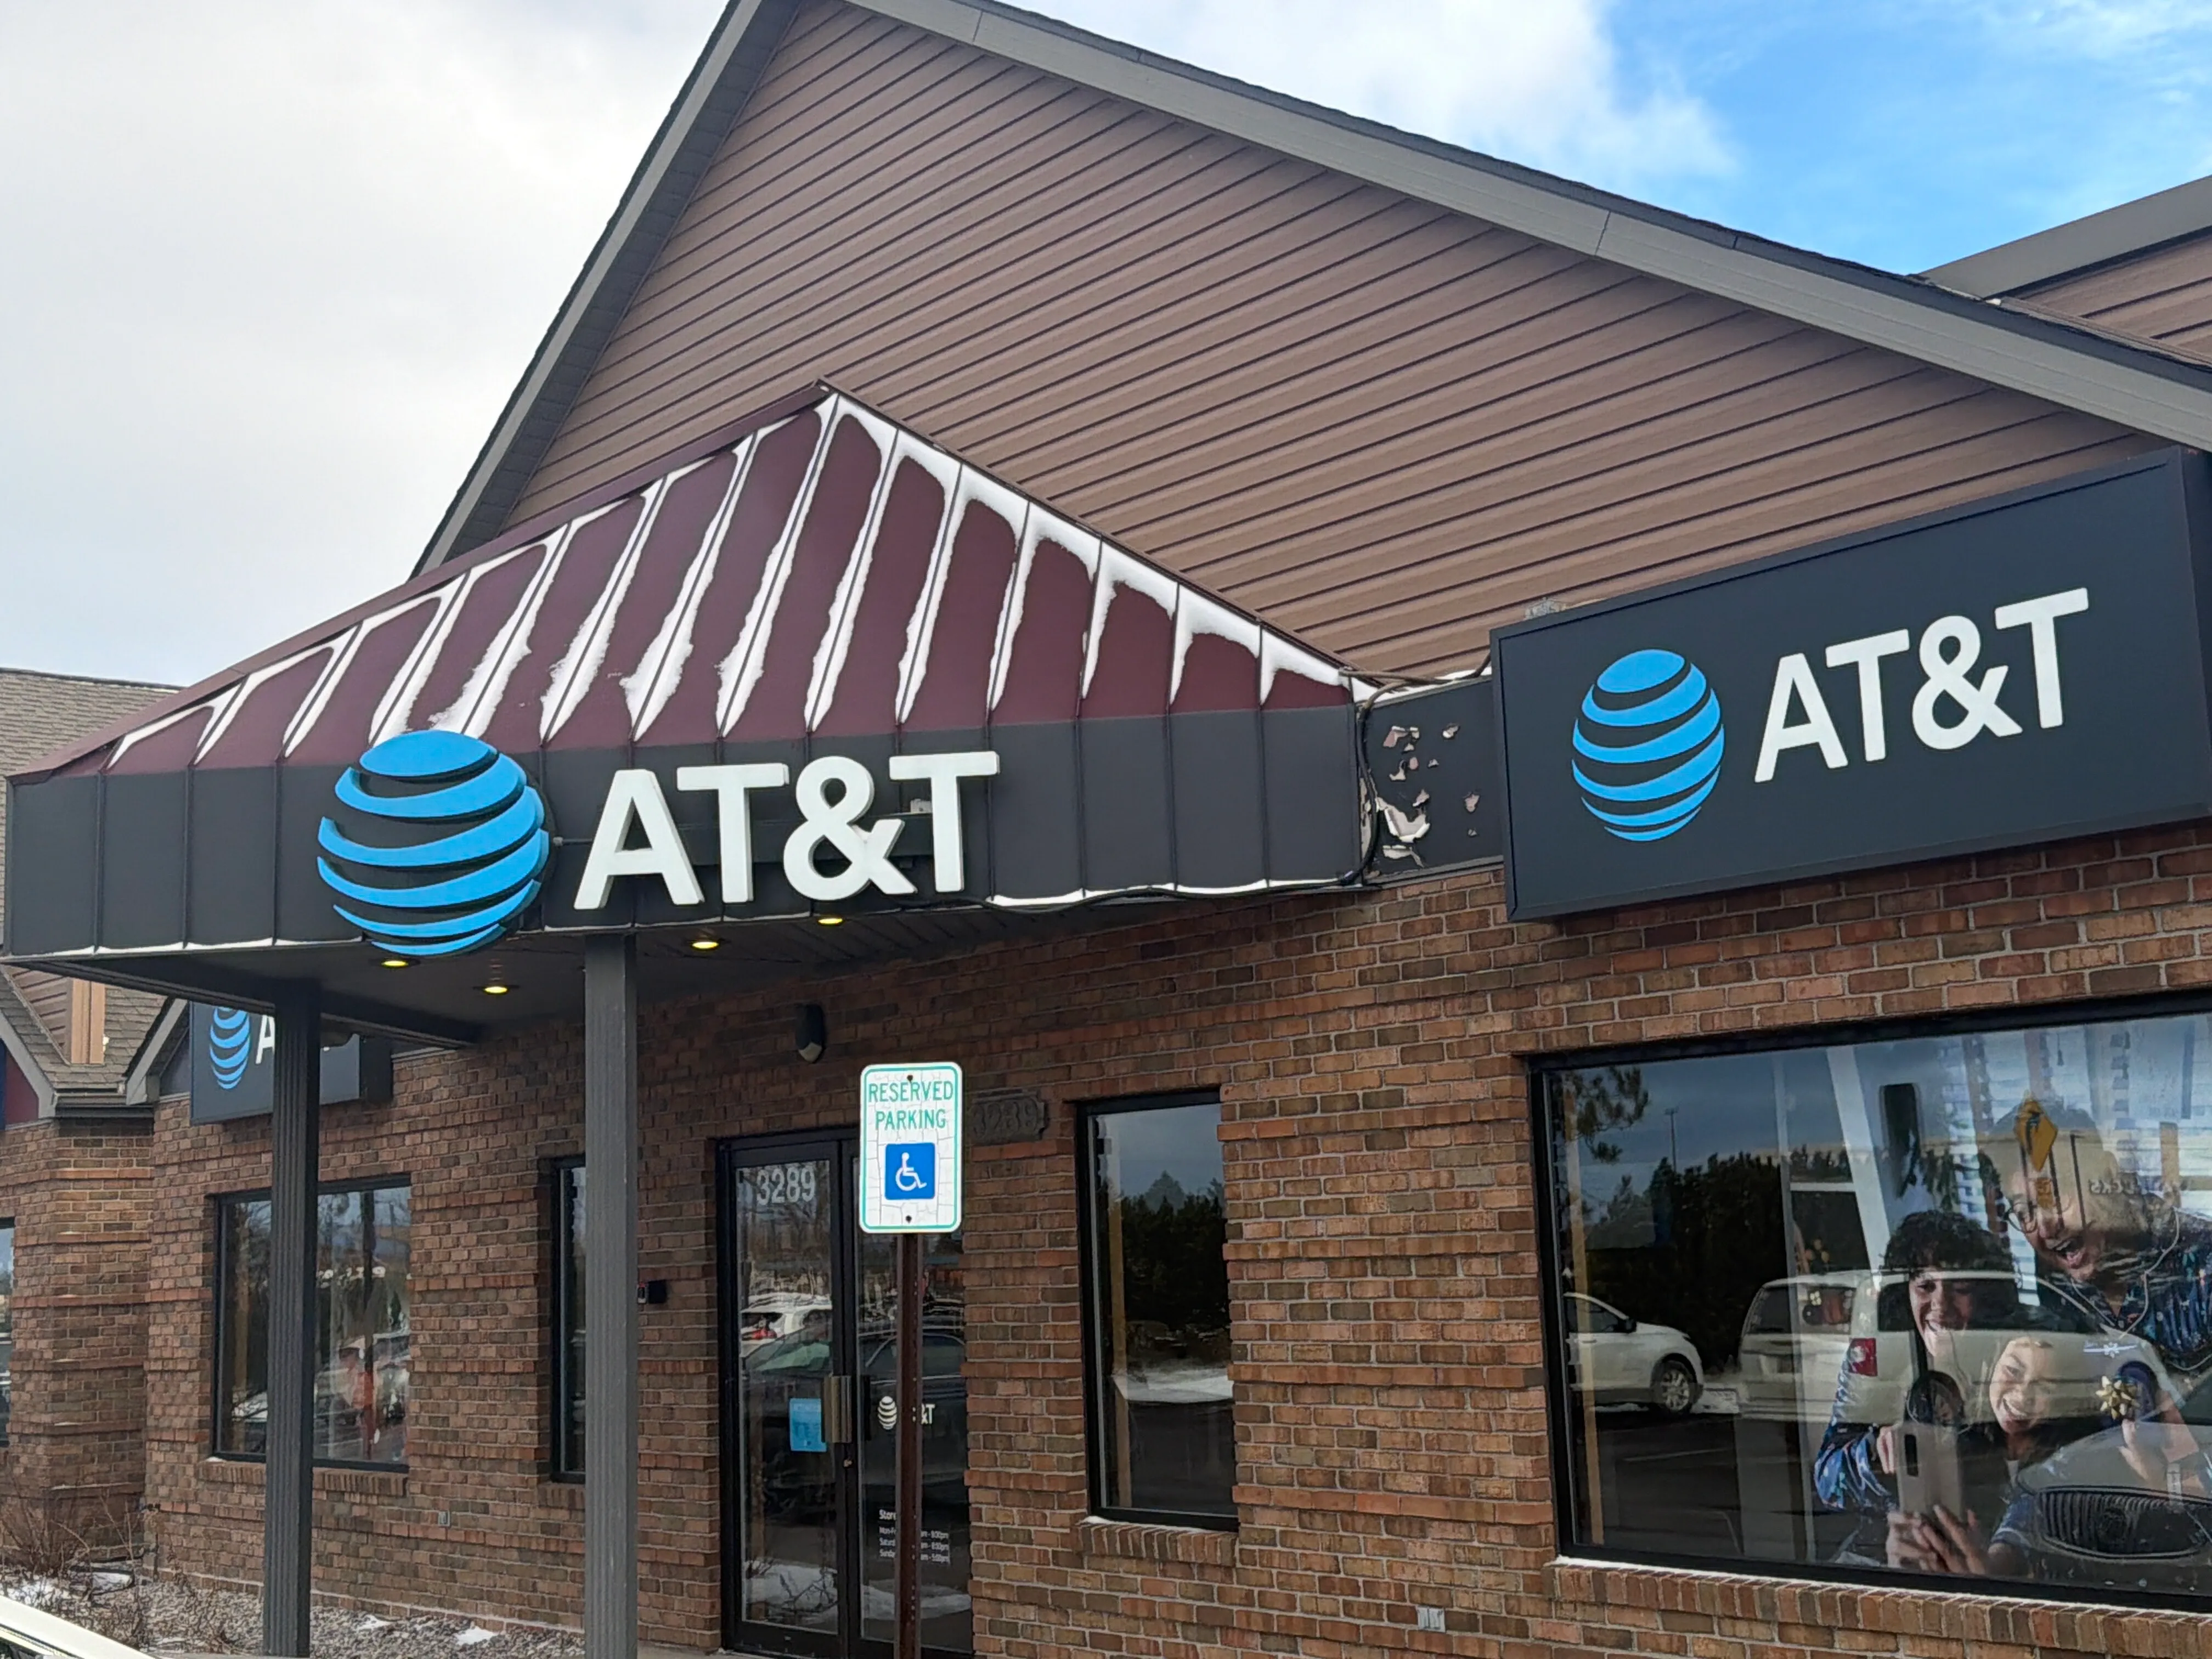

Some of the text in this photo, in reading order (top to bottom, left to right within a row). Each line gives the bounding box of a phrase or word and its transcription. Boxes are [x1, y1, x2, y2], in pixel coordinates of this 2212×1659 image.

[1754, 587, 2089, 783] AT&T
[573, 751, 1000, 910] AT&T
[868, 1080, 953, 1103] RESERVED
[875, 1108, 946, 1130] PARKING
[757, 1165, 815, 1205] 3289
